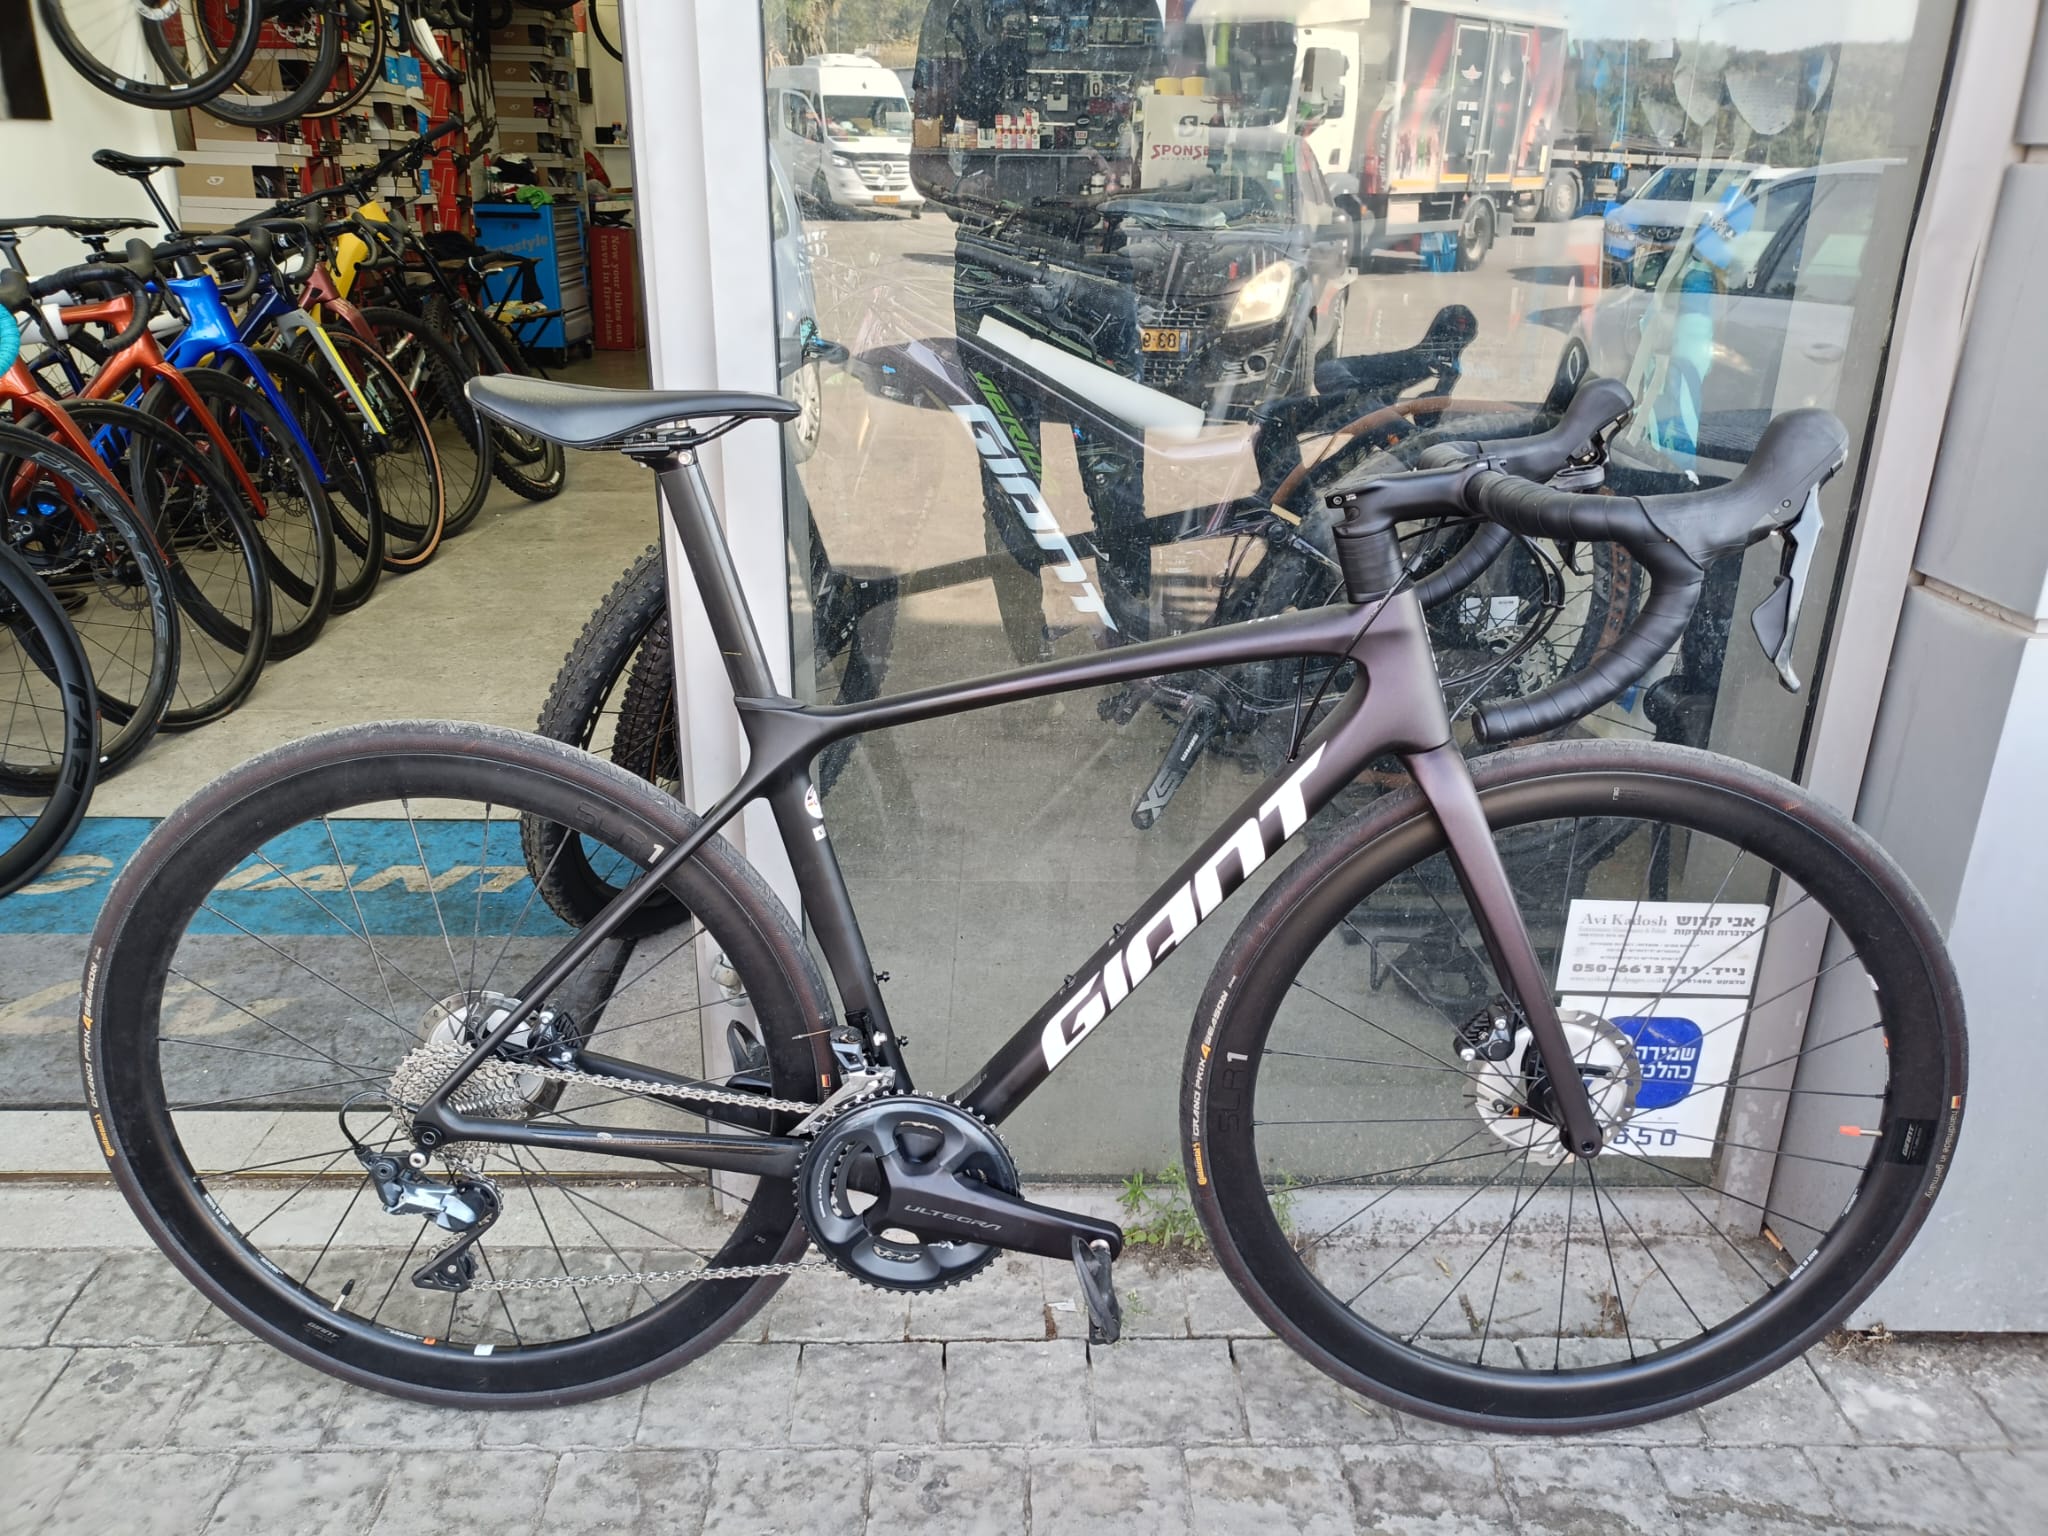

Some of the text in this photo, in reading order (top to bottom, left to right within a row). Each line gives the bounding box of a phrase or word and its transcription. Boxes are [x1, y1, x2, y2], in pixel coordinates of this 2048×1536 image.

[1151, 144, 1209, 160] SPONSE
[600, 235, 610, 269] travel
[603, 286, 612, 310] first
[611, 235, 623, 343] Now your bikes can
[975, 371, 1042, 481] MERID
[949, 404, 1119, 633] GIANT
[213, 863, 530, 894] IANT
[1041, 740, 1328, 1072] GIANT
[1580, 913, 1668, 928] Avi Kadosh
[1727, 916, 1756, 928] אבי
[1636, 1045, 1697, 1062] שמירה
[1641, 1061, 1692, 1079] כהלכ
[903, 1203, 1002, 1232] ULTEGRA
